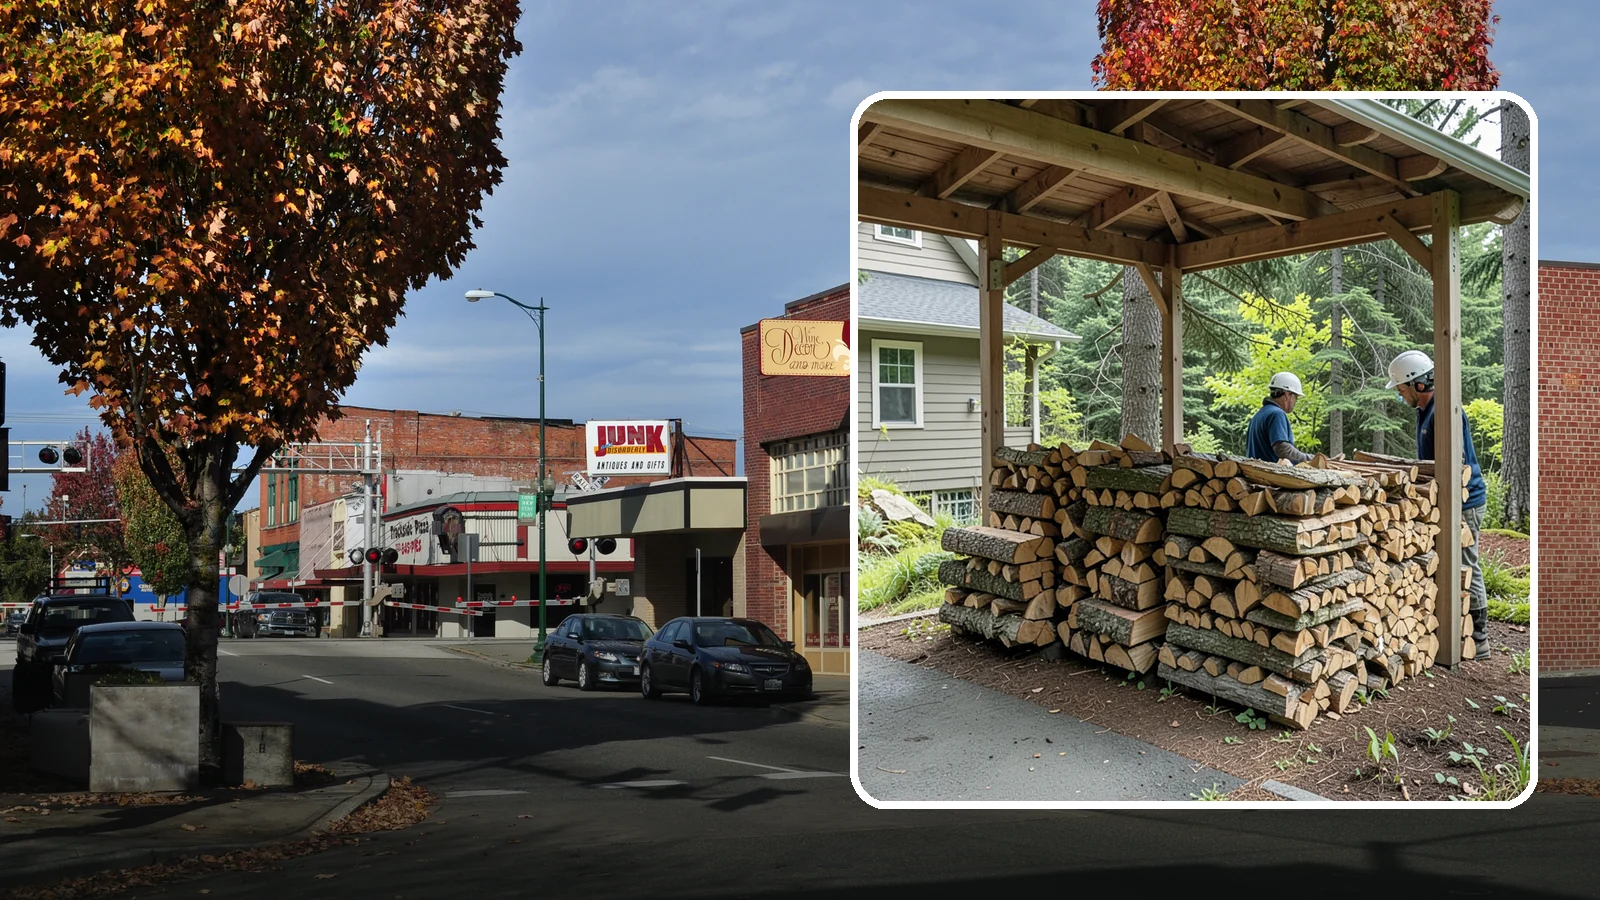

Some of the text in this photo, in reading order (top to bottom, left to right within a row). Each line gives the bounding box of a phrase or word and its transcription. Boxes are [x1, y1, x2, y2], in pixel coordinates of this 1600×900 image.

[596, 425, 665, 457] JUNK
[607, 446, 646, 454] DISORDERLY
[597, 460, 665, 470] ANTIQUES AND GIFTS
[414, 519, 429, 535] Pizza
